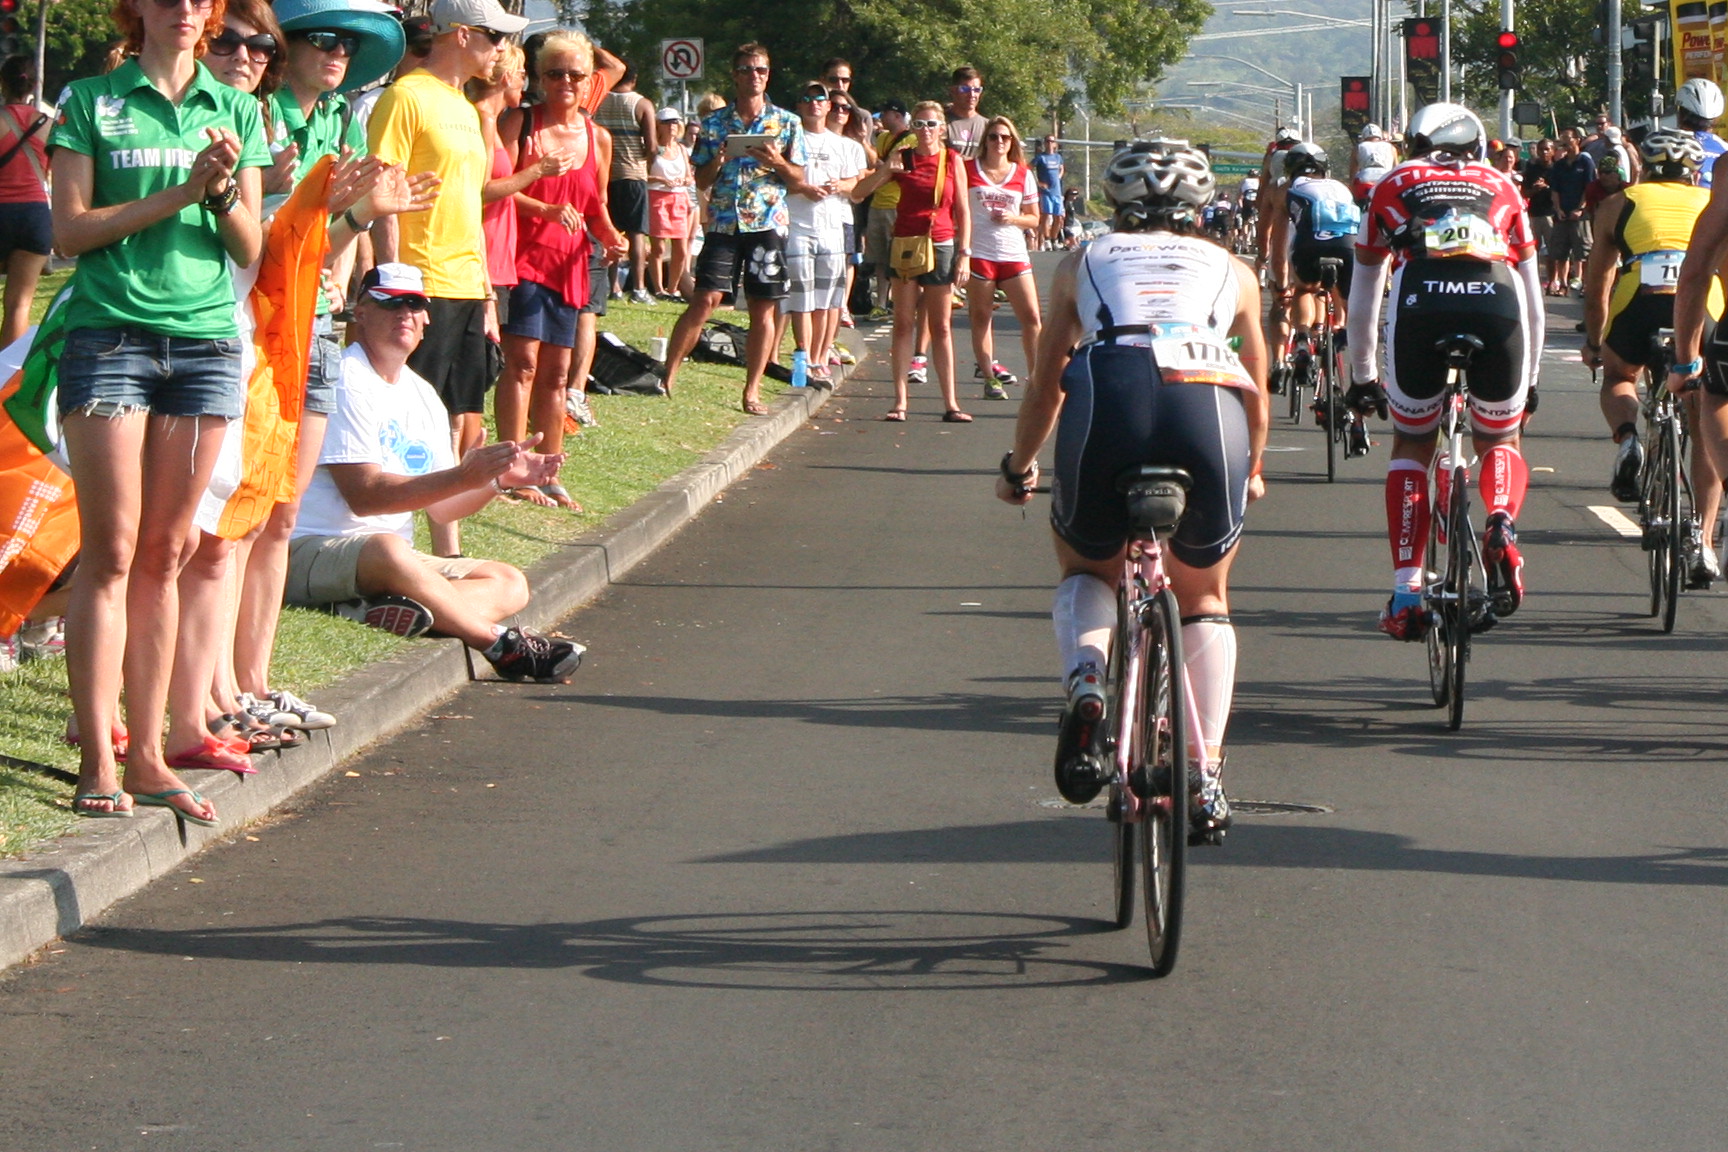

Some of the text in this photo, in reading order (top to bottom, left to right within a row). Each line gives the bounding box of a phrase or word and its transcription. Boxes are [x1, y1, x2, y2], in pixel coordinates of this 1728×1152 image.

[110, 148, 160, 169] TEAM
[1388, 169, 1503, 191] TIMEX
[1423, 281, 1497, 295] TIMEX
